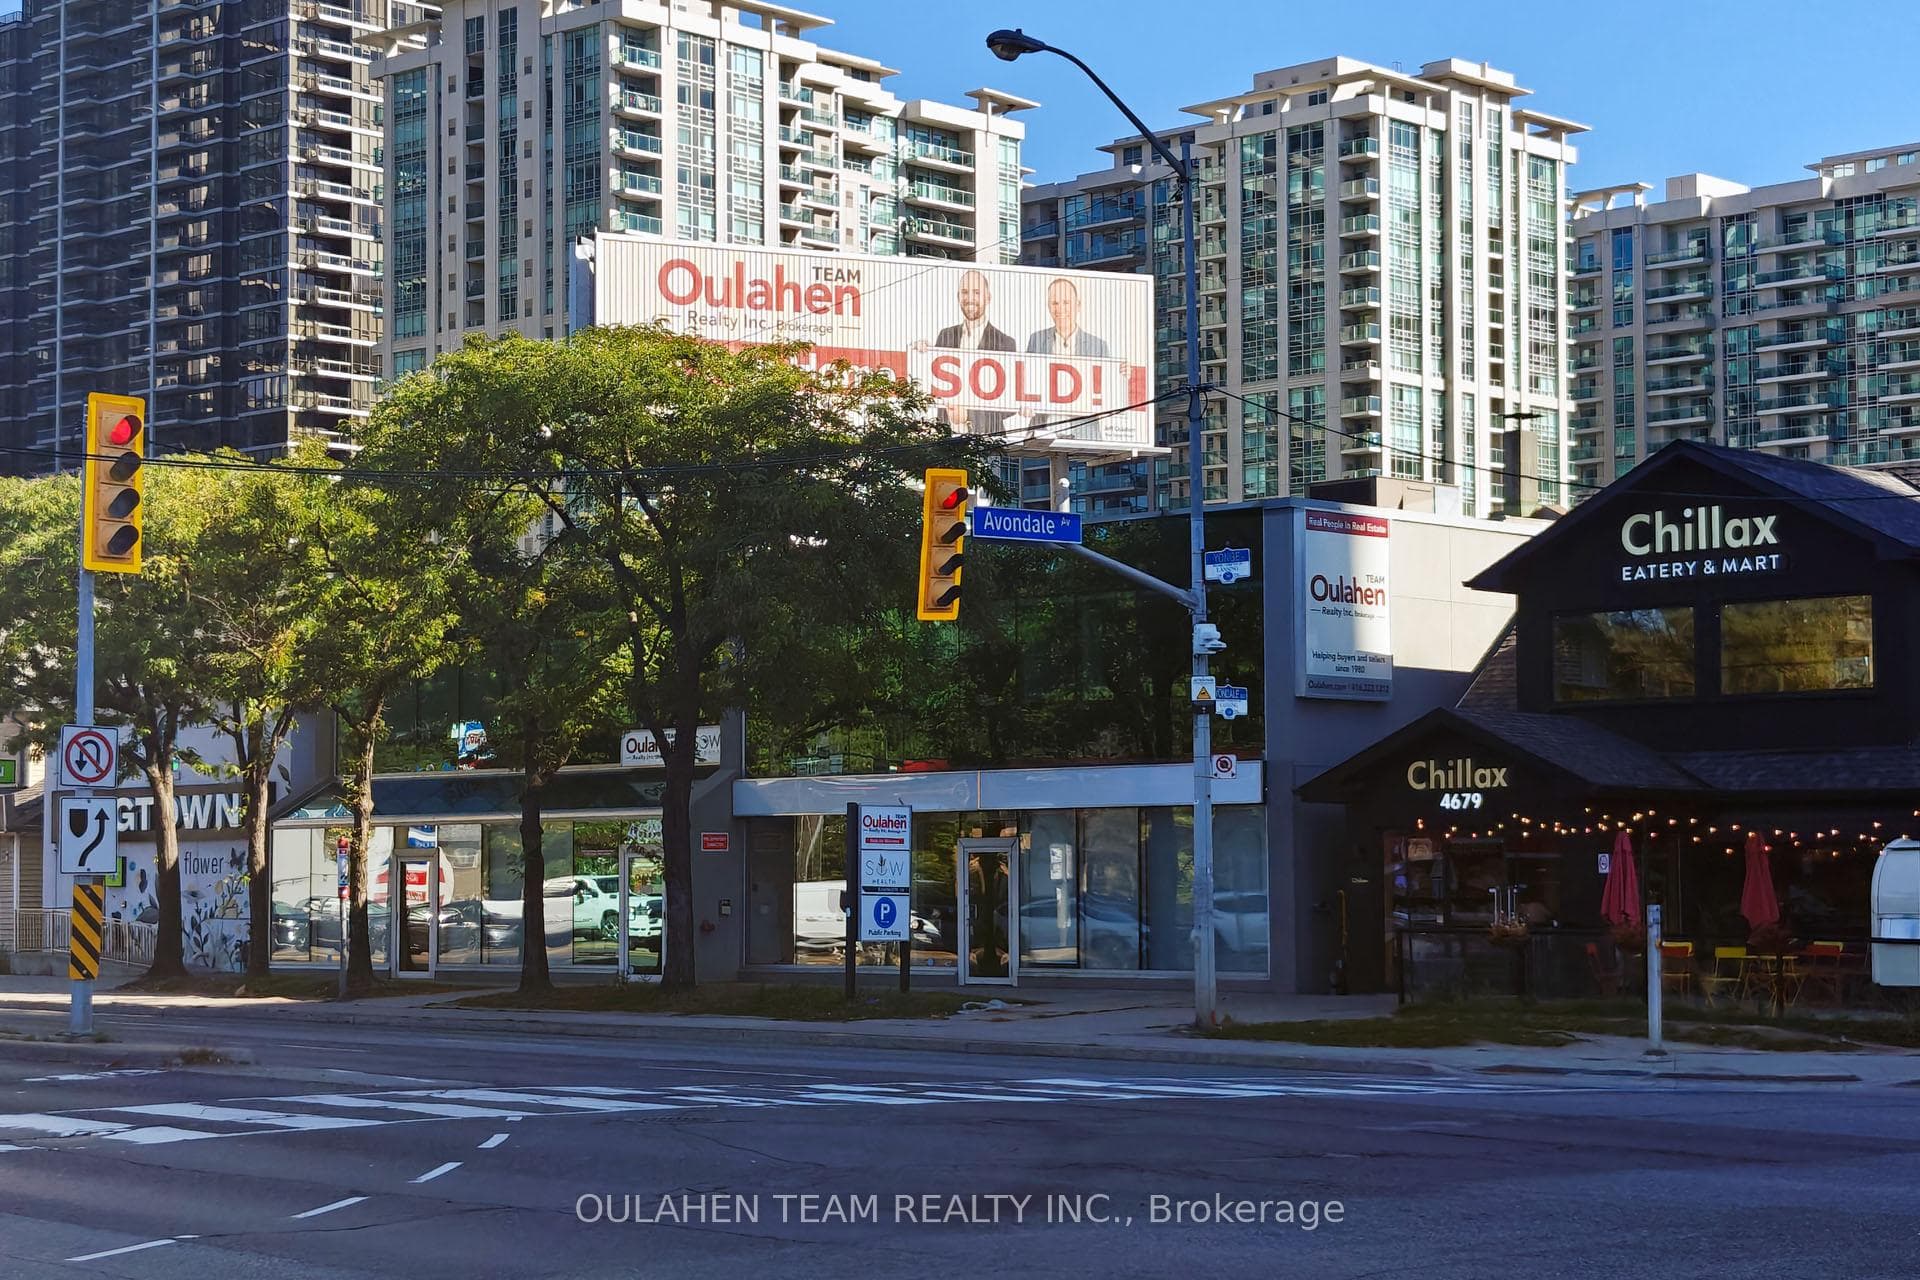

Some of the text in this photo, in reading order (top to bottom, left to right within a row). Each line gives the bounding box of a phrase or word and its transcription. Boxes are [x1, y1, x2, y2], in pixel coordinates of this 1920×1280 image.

[812, 266, 861, 284] TEAM
[658, 258, 861, 317] Oulahen
[688, 310, 833, 337] Realty Inc. Brokerage
[930, 355, 1102, 406] SOLD!
[984, 511, 1071, 535] Avondale Av
[1309, 516, 1323, 527] Real
[1323, 518, 1344, 530] People
[1352, 521, 1366, 531] Real
[1367, 523, 1386, 534] Estate
[1621, 505, 1779, 556] Chillax
[1622, 554, 1780, 581] EATERY & MART
[1366, 574, 1385, 584] TEAM
[1310, 574, 1386, 607] Oulahen
[1322, 607, 1342, 618] Realty
[1312, 651, 1336, 663] Helping
[1337, 653, 1356, 663] buyers
[1335, 663, 1350, 672] since
[1407, 758, 1508, 790] Chillax
[1440, 792, 1484, 810] 4679
[116, 793, 240, 832] GTWN
[863, 814, 907, 830] Oulahen
[184, 851, 224, 875] flower
[881, 903, 890, 920] P
[884, 929, 902, 938] Parking
